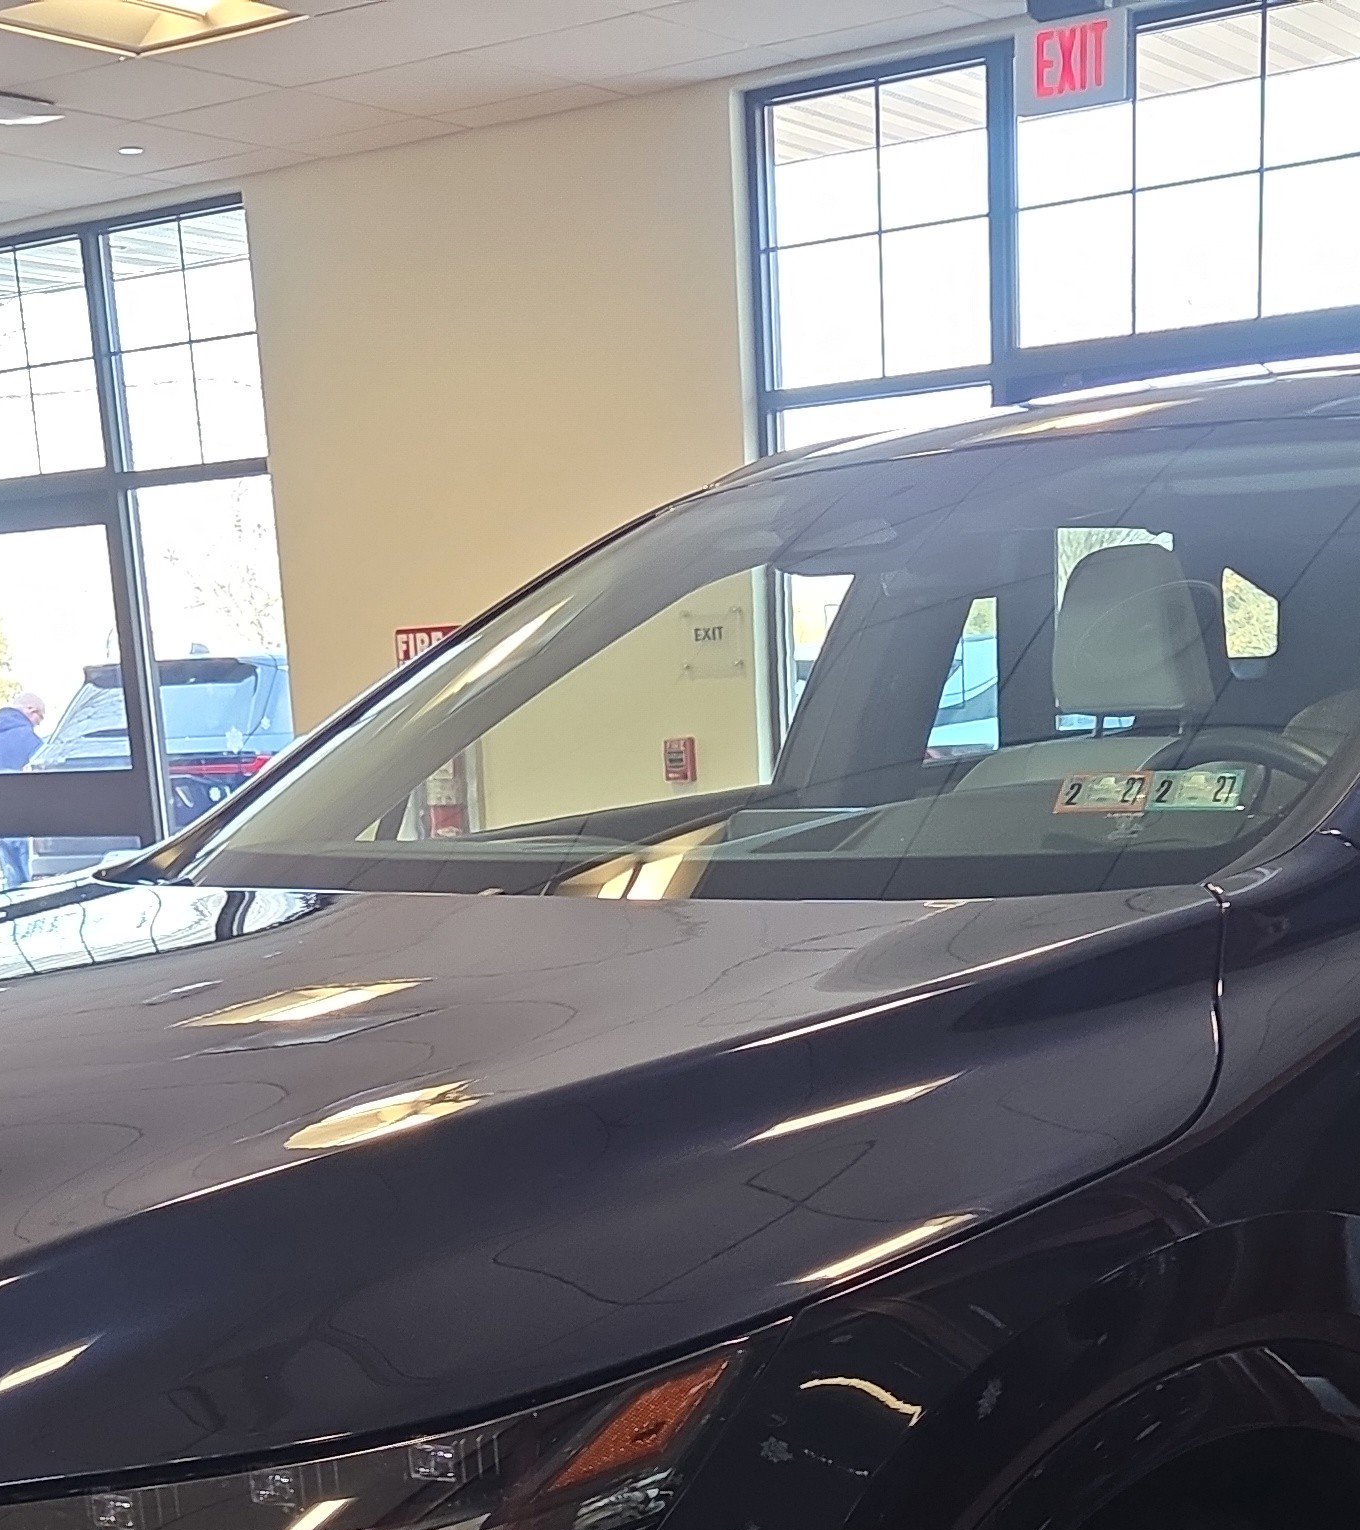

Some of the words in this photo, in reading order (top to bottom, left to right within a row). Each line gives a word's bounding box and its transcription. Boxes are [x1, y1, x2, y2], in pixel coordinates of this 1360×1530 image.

[1035, 20, 1108, 97] EXIT
[396, 631, 443, 660] FIR
[693, 626, 723, 641] EXIT
[1064, 783, 1083, 805] 2
[1154, 779, 1173, 803] 2
[1212, 775, 1237, 803] 27
